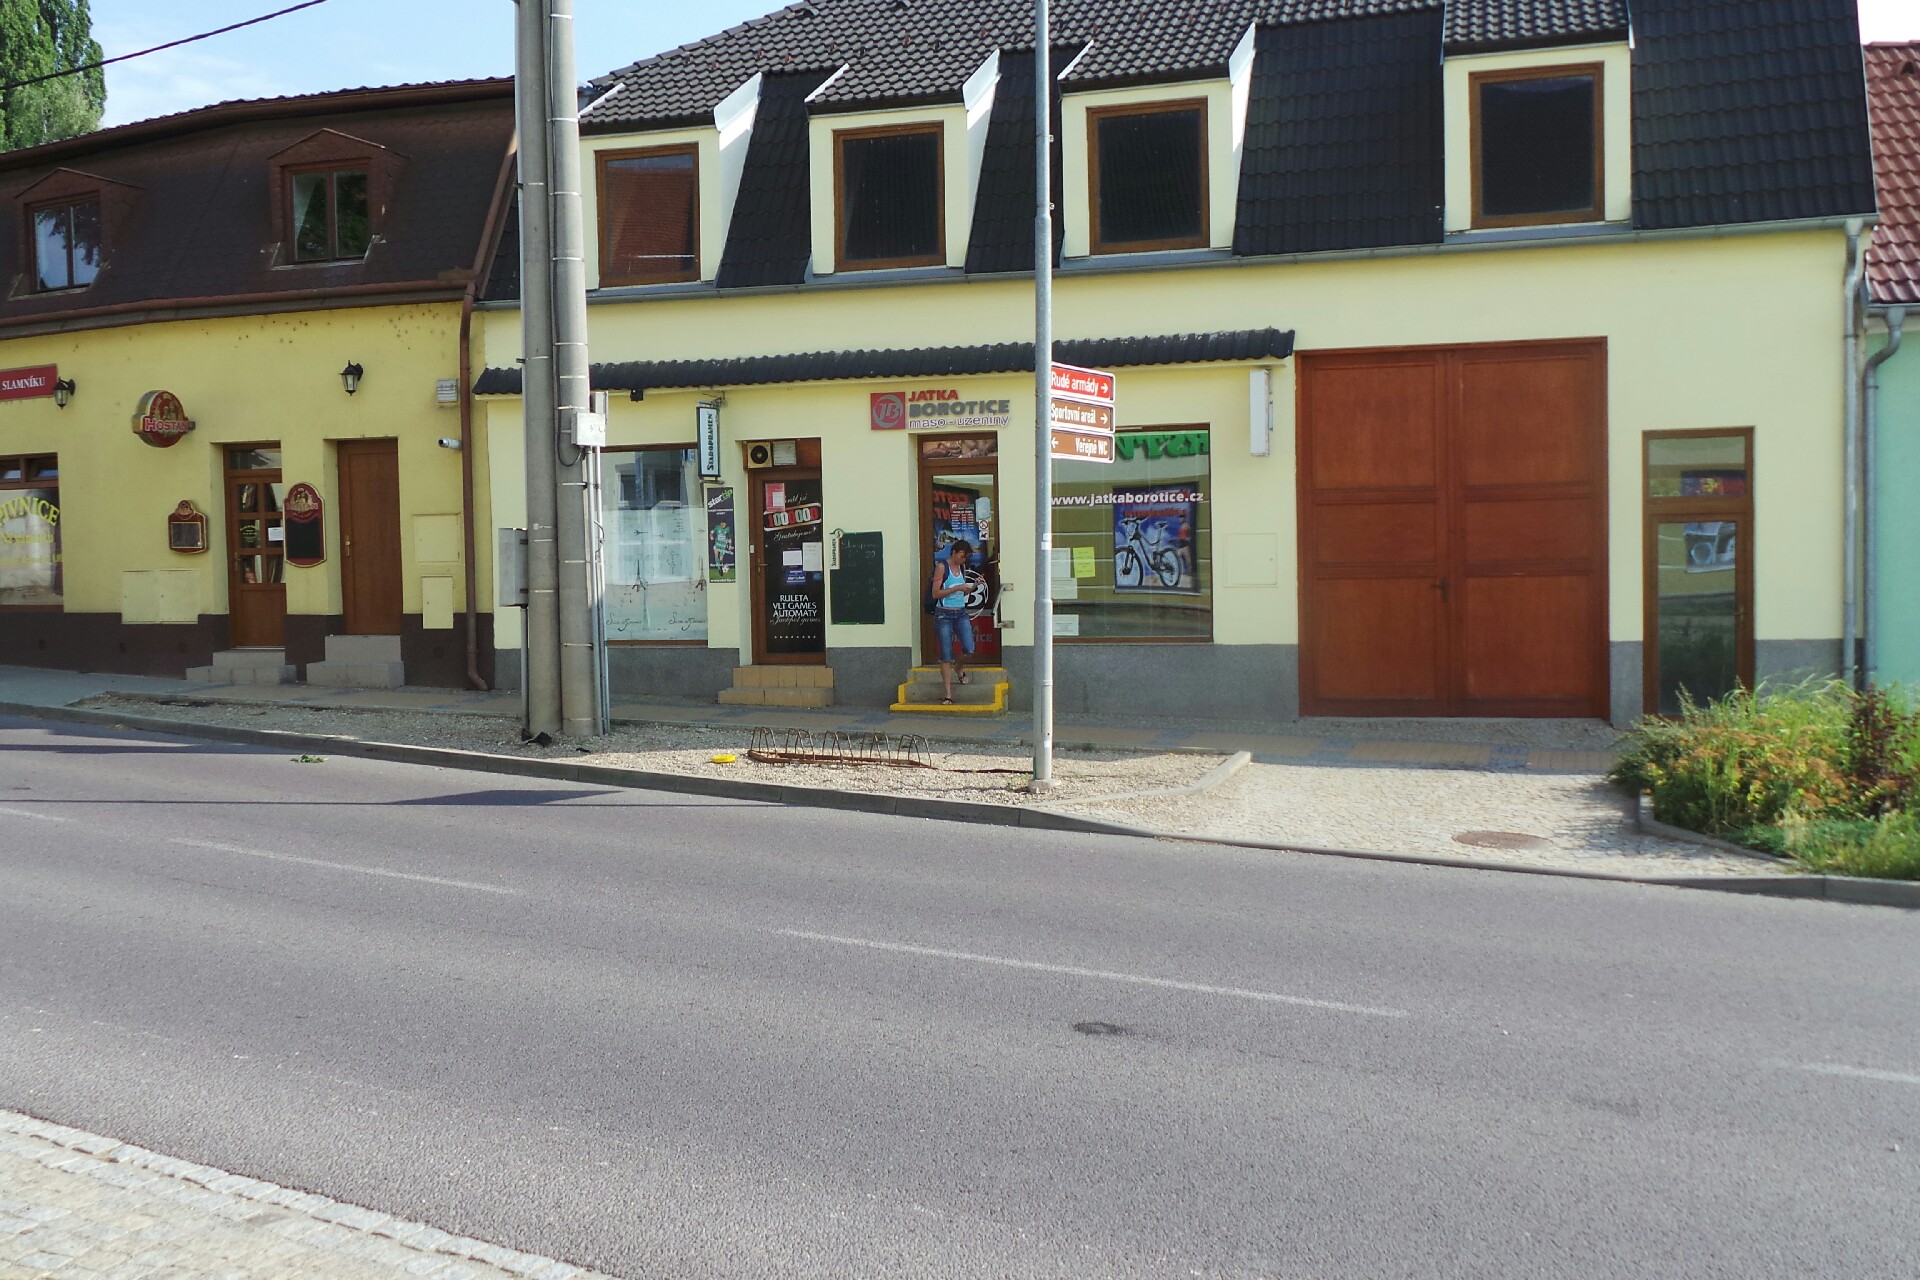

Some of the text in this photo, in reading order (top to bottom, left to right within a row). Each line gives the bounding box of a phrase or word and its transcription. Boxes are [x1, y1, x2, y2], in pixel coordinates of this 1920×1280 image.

[2, 376, 46, 391] SLAMNÍKU
[1051, 371, 1099, 397] Rudé armády
[908, 389, 959, 402] JATKA
[908, 400, 1010, 418] BOROTICE
[1051, 403, 1096, 424] Sportovní areál
[144, 417, 189, 432] HOSTAN
[909, 418, 947, 429] maso
[957, 413, 1010, 428] uzeniny
[1075, 437, 1097, 457] Veřejné
[1097, 440, 1108, 456] WC
[1051, 492, 1204, 507] www.jatkaborotice.cz
[779, 594, 809, 602] RULETA
[772, 602, 817, 610] VLT GAMES
[772, 609, 818, 618] AUTOMATY
